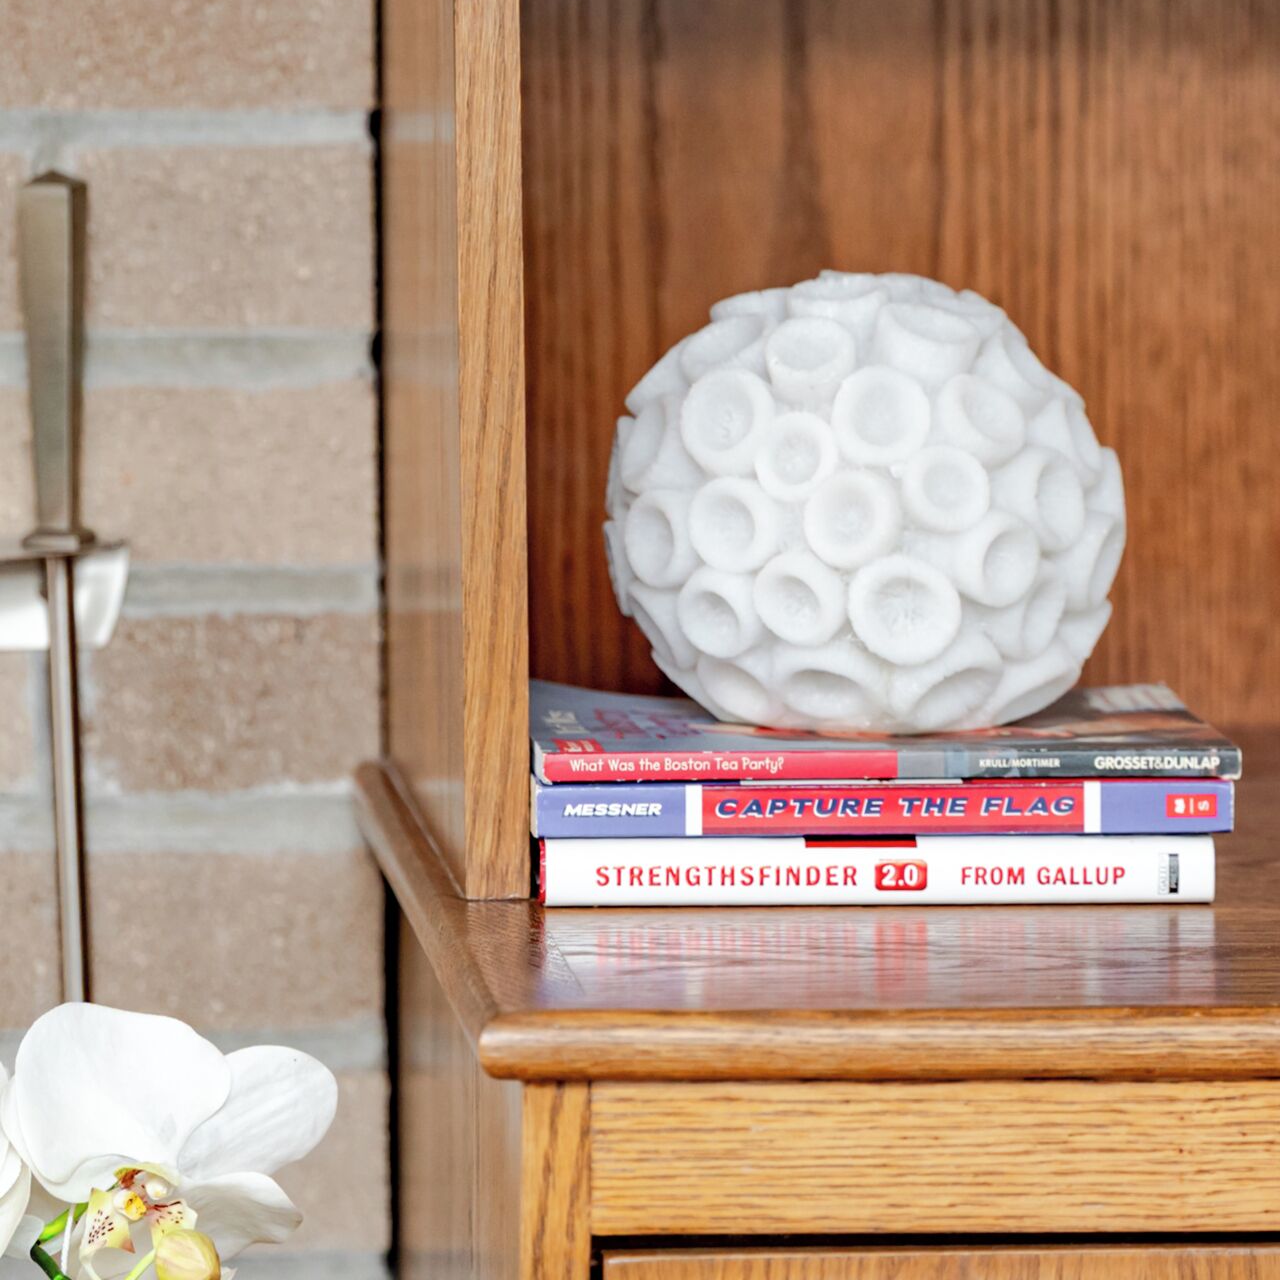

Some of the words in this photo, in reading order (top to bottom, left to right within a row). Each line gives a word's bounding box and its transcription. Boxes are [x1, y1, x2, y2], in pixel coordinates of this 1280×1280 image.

[570, 757, 604, 772] What
[608, 757, 635, 772] Was
[639, 756, 660, 771] the
[664, 756, 711, 771] Boston
[714, 757, 738, 771] Tea
[741, 755, 784, 773] Party?
[1093, 755, 1221, 770] GROSSET&DUNLAP
[563, 802, 663, 818] MESSNER
[714, 797, 885, 819] CAPTURE
[898, 796, 968, 817] THE
[979, 796, 1076, 817] FLAG
[595, 865, 859, 887] STRENGTHSFINDER
[880, 864, 919, 887] 2.0
[961, 866, 1025, 886] FROM
[1036, 866, 1126, 886] GALLUP
